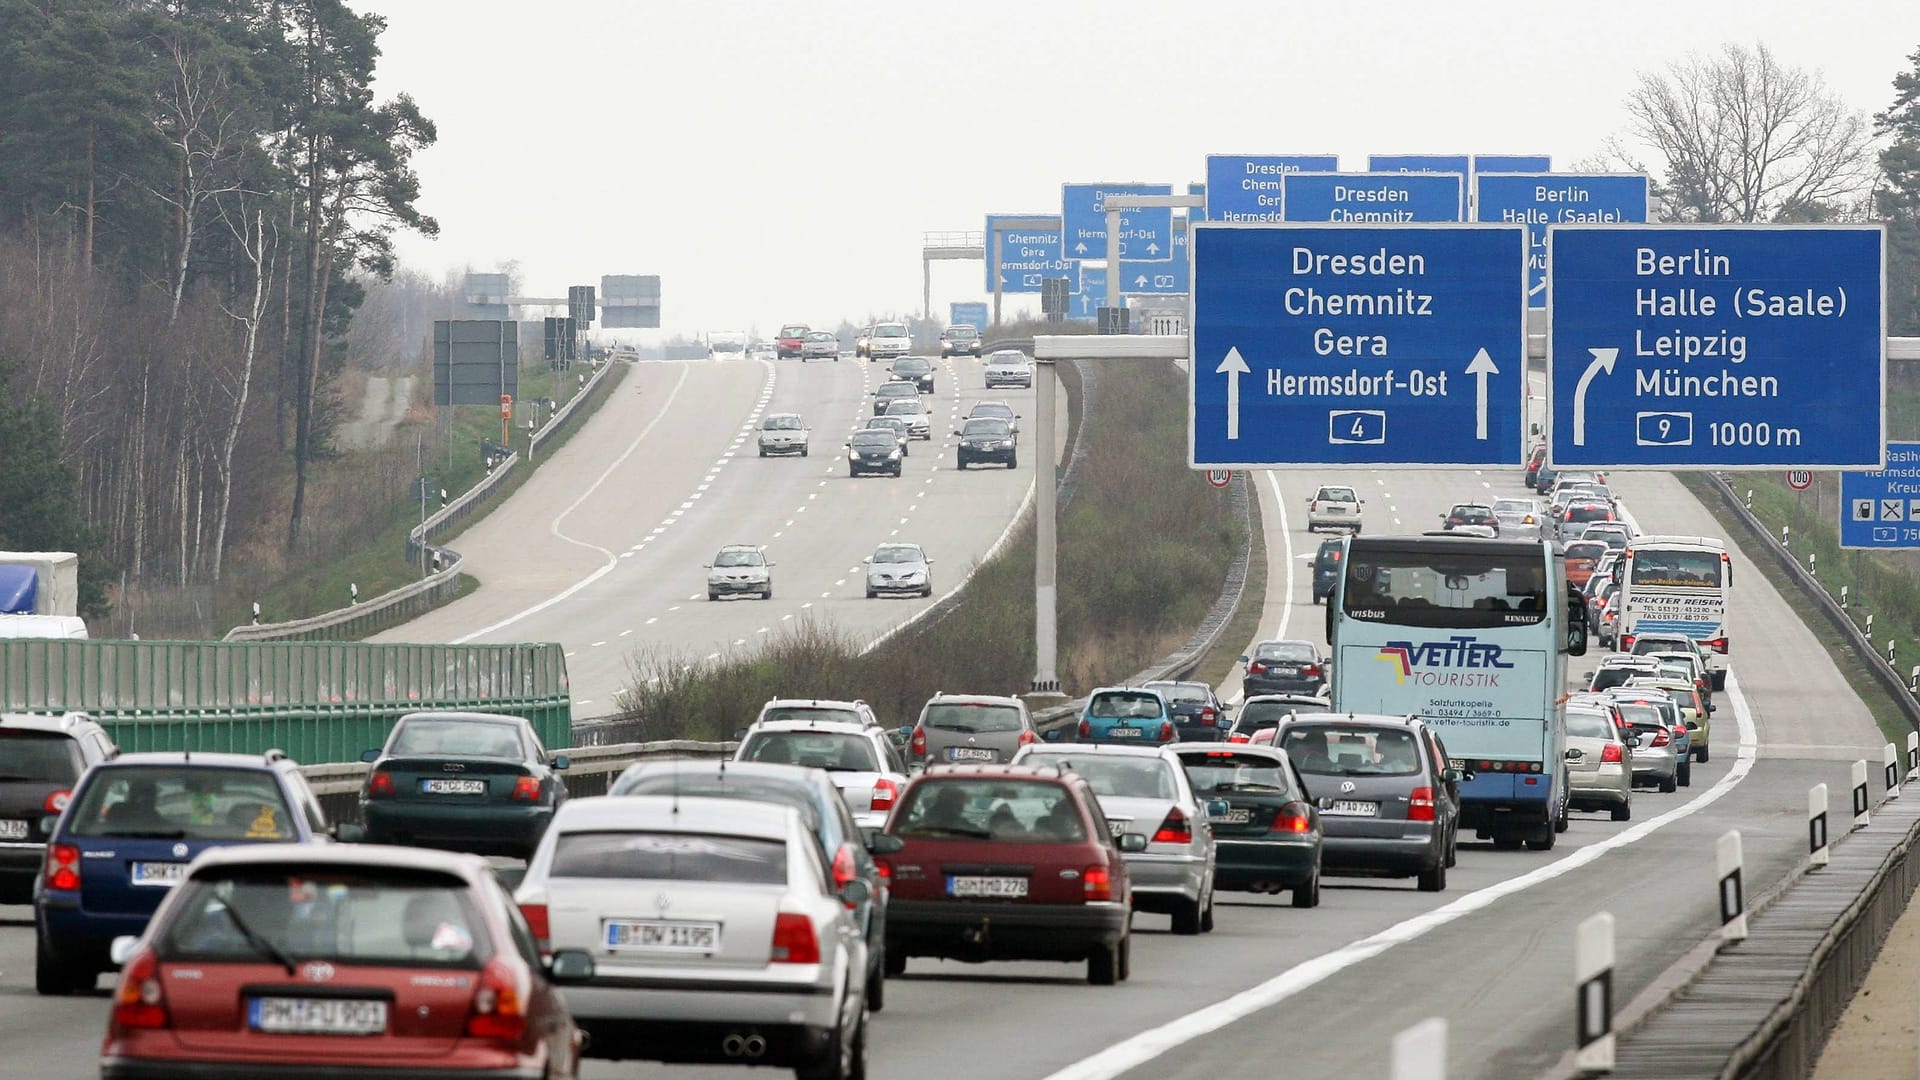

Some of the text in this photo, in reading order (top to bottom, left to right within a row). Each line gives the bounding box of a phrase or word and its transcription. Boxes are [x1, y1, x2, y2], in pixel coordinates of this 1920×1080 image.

[1246, 162, 1299, 174] Dresden
[1242, 179, 1281, 190] Chem
[1258, 195, 1281, 206] Ger
[1335, 186, 1409, 202] Dresden
[1535, 186, 1589, 202] Berlin
[1224, 211, 1281, 222] Hermsdo
[1330, 208, 1414, 223] Chemnitz
[1502, 207, 1621, 224] Halle (Saale)
[1008, 233, 1058, 245] Chemnitz
[1021, 247, 1045, 258] Gera
[1001, 261, 1072, 271] ermsdorf-Ost
[1292, 247, 1425, 275] Dresden
[1636, 248, 1730, 276] Berlin
[1284, 287, 1433, 315] Chemnitz
[1636, 287, 1847, 318] Halle (Saale)
[1314, 328, 1388, 356] Gera
[1636, 329, 1747, 364] Leipzig
[1267, 368, 1448, 397] Hermsdorf-Ost
[1636, 369, 1778, 398] München
[1350, 417, 1364, 438] 4
[1658, 419, 1671, 440] 9
[1710, 422, 1801, 446] 1000 m
[1886, 450, 1920, 462] Rasth
[1212, 469, 1227, 481] 100
[1792, 470, 1808, 483] 100
[1888, 482, 1920, 494] Kreu
[1881, 529, 1888, 539] 9
[1357, 565, 1371, 580] 100
[1684, 598, 1724, 606] REISEN
[1504, 615, 1540, 623] RENAULT
[1386, 636, 1514, 669] VETTER
[1414, 671, 1500, 688] TOURISTIK
[1003, 879, 1027, 894] 278
